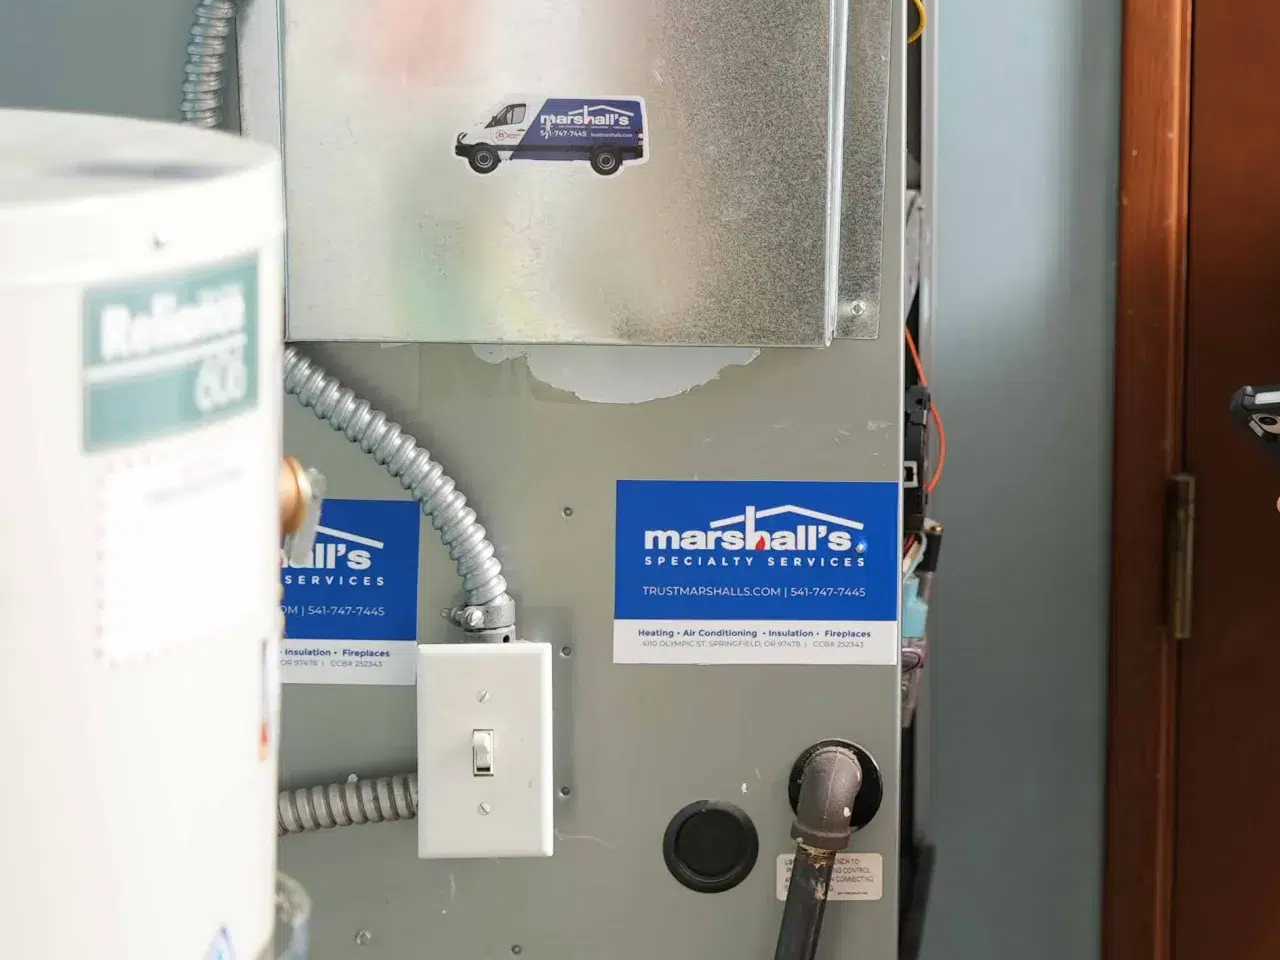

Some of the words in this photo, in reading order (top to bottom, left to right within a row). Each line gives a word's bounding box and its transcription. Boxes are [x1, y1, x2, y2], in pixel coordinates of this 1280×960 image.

[540, 105, 630, 126] marshall's
[644, 505, 851, 551] marshall's
[644, 556, 753, 566] SPECIALTY
[767, 557, 865, 567] SERVICES
[285, 576, 384, 586] SERVICES
[643, 586, 781, 597] TRUSTMARSHALLS.COM
[790, 587, 866, 597] 541-747-7445
[307, 606, 385, 617] 541-747-7445
[638, 629, 674, 639] Heating
[683, 629, 697, 638] Air
[698, 629, 758, 639] Conditioning
[768, 630, 814, 638] Insulation
[824, 630, 872, 640] Fireplaces
[285, 648, 331, 656] Insulation
[342, 649, 390, 658] Fireplaces
